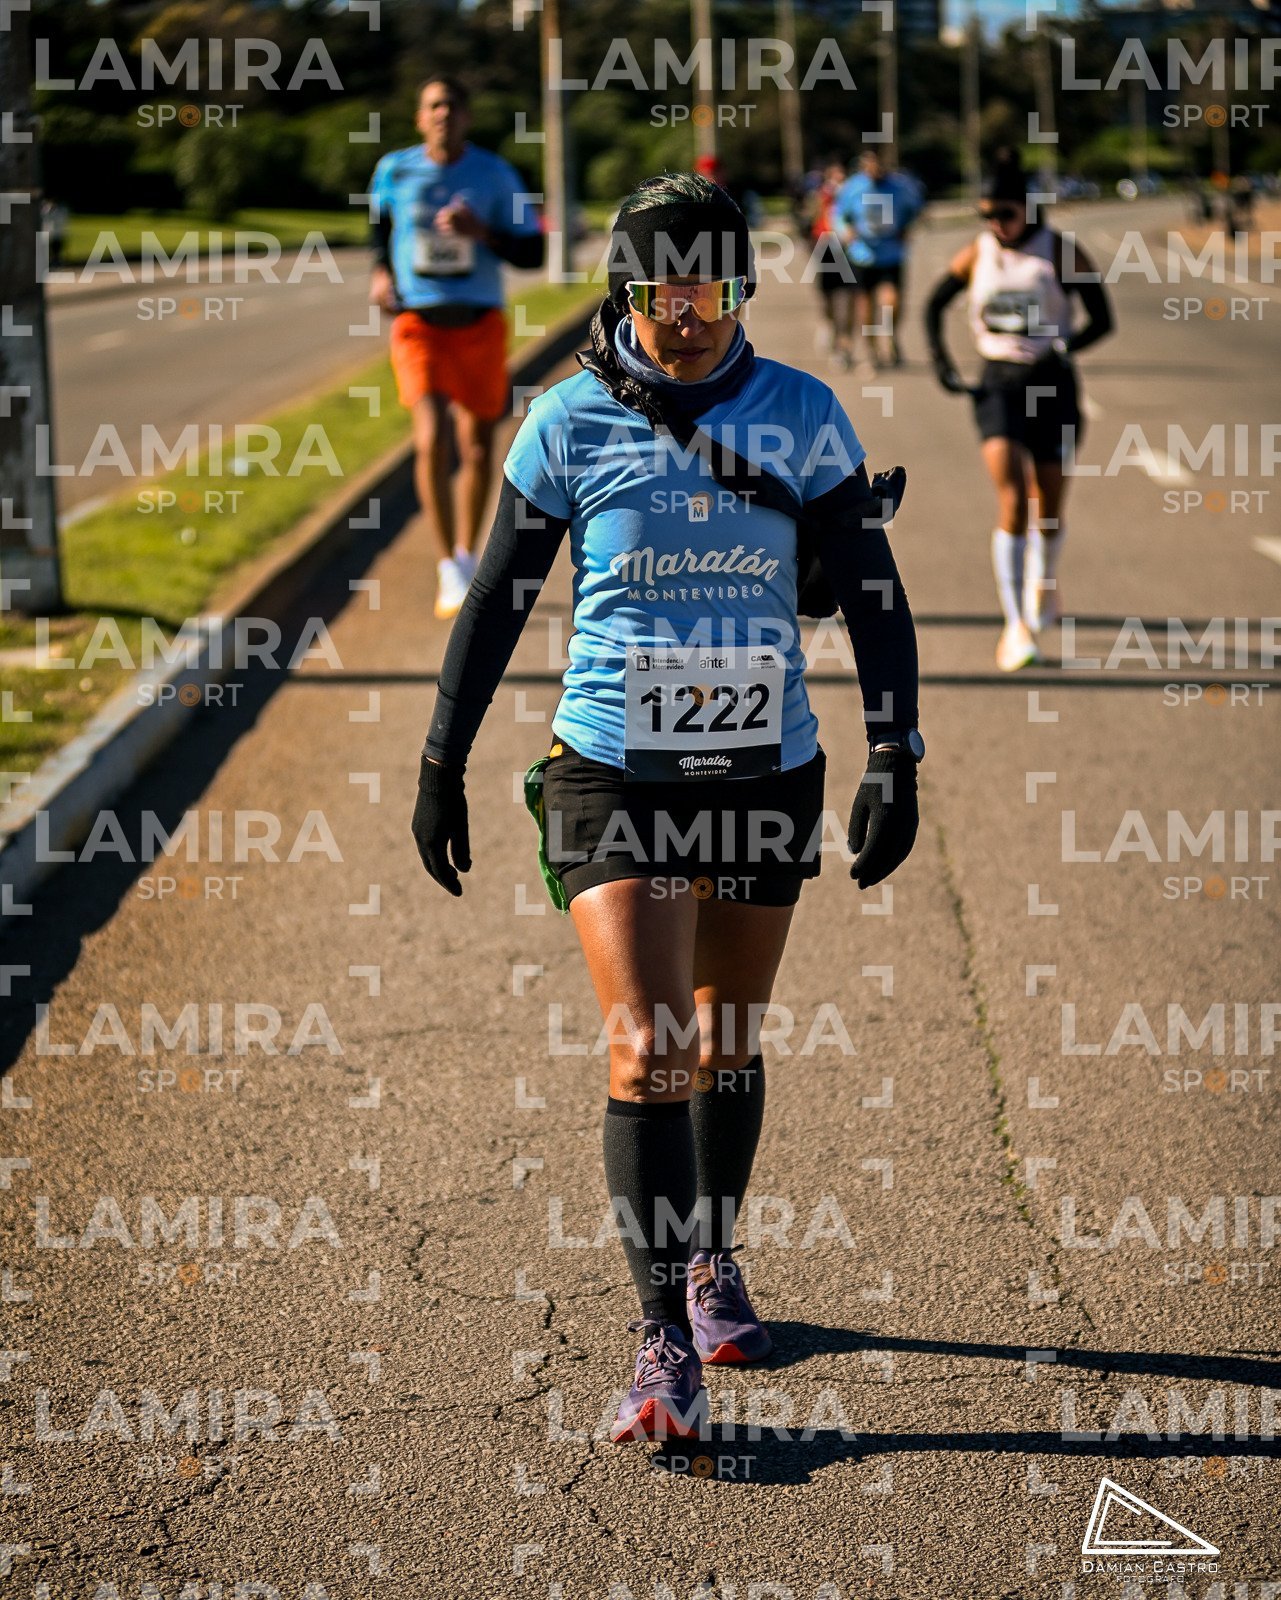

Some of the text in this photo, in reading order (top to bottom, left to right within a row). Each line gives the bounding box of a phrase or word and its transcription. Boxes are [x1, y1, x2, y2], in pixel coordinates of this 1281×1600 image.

[610, 544, 780, 586] Maratón
[627, 583, 765, 602] MONTEVIDEO
[700, 656, 728, 669] antel
[640, 683, 770, 733] 1222
[678, 755, 733, 769] Maratón
